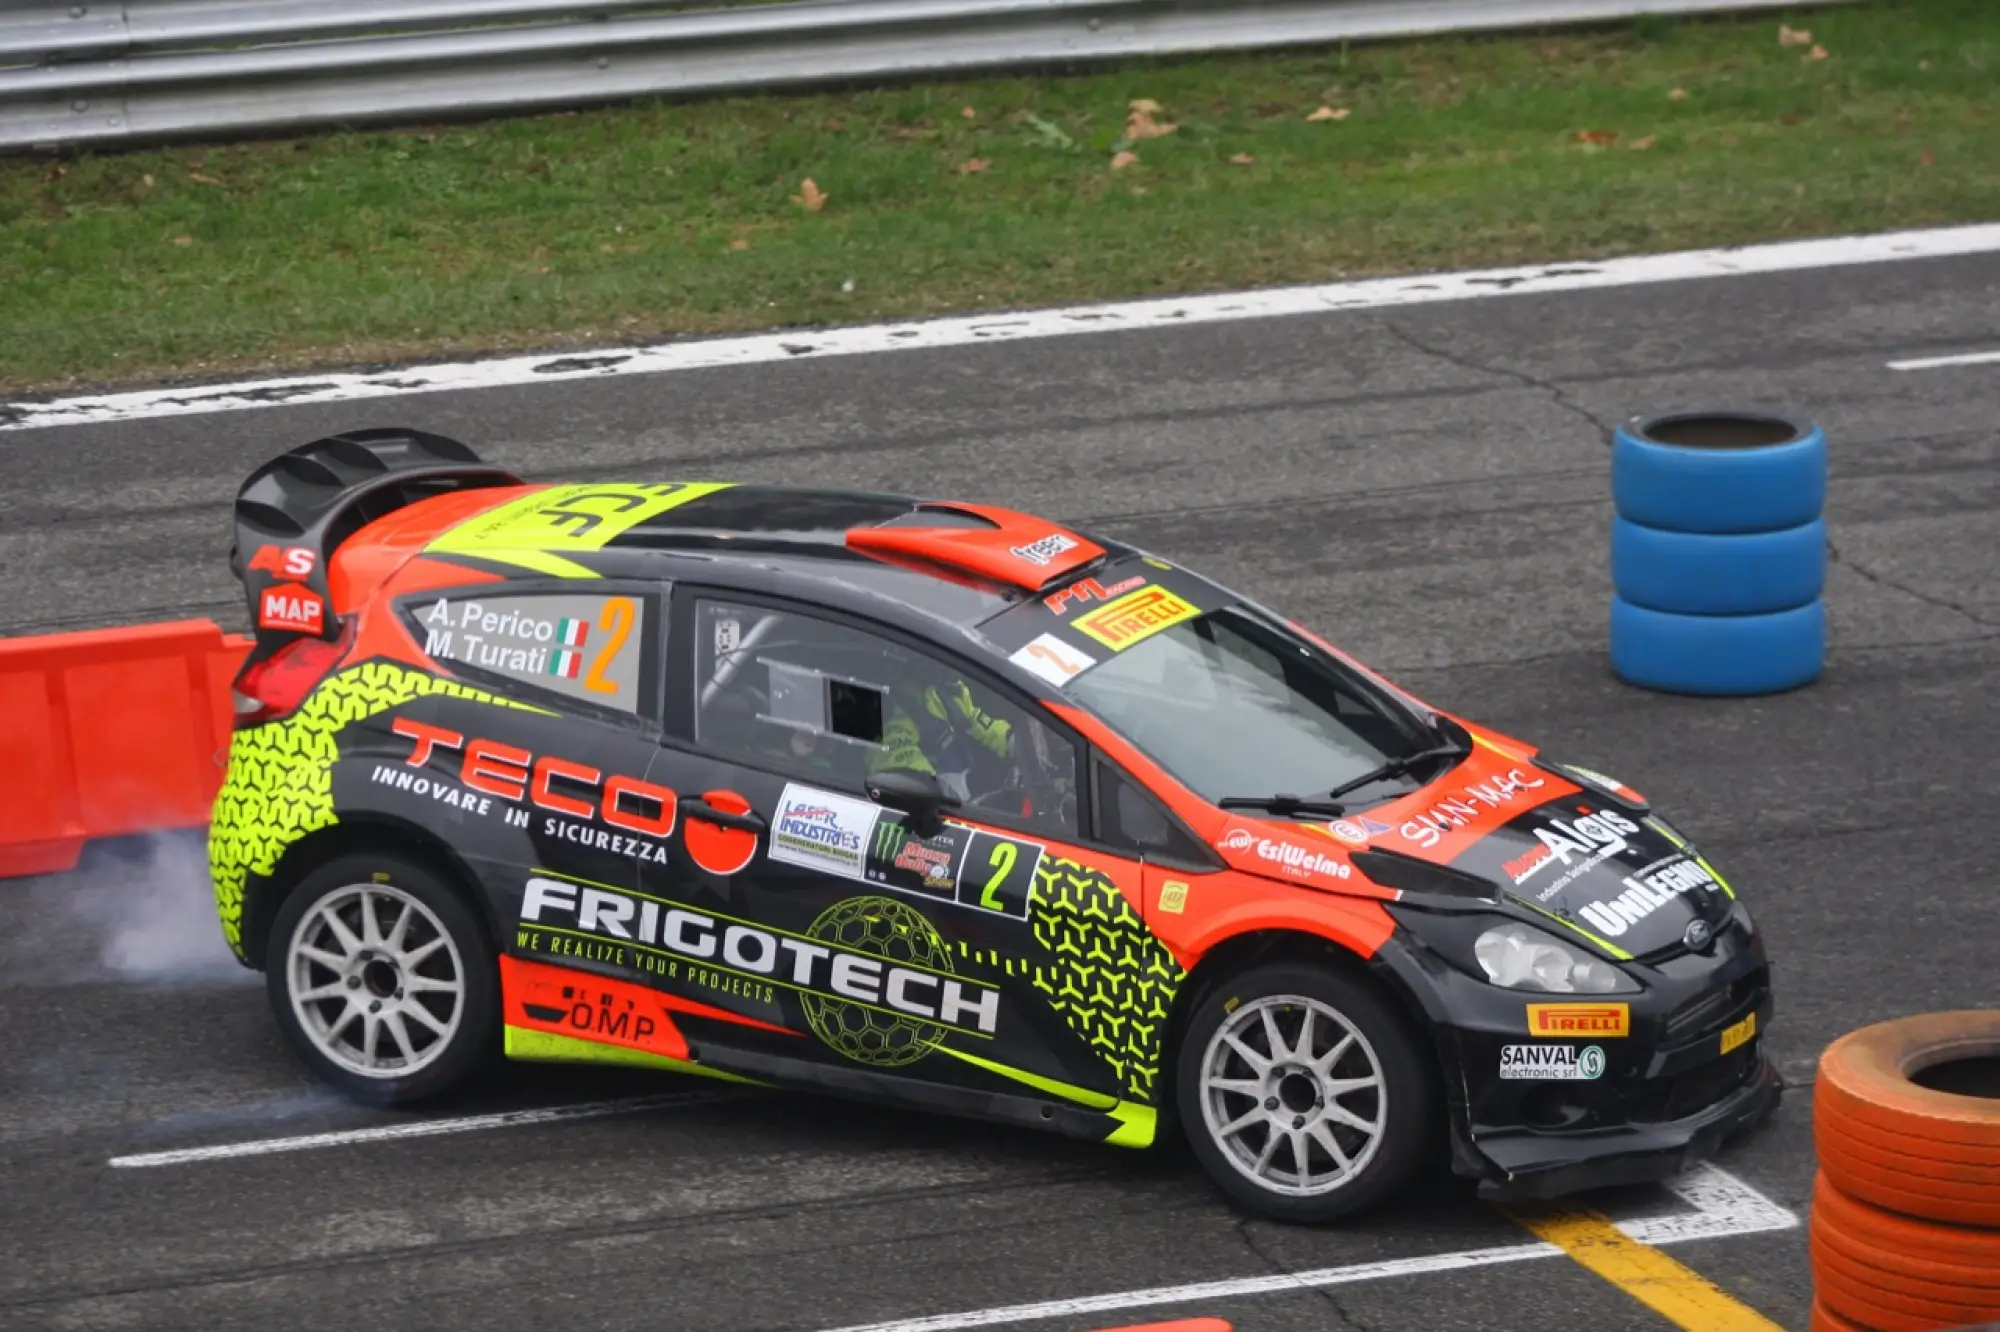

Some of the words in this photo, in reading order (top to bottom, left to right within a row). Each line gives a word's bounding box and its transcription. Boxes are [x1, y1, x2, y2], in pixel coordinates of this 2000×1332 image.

[266, 594, 321, 622] MAP
[427, 598, 456, 627] A.
[461, 602, 553, 642] Perico
[1085, 591, 1186, 643] PIRELLI
[424, 628, 456, 660] M.
[463, 634, 548, 675] Turati
[583, 595, 636, 695] 2
[1026, 642, 1082, 676] 2
[392, 716, 678, 839] TECO
[372, 765, 492, 816] INNOVARE
[504, 806, 530, 829] IN
[544, 818, 668, 865] SICUREZZA
[1533, 804, 1640, 866] Algis
[979, 842, 1018, 912] 2
[1282, 865, 1312, 879] ITALY
[516, 931, 540, 951] WE
[550, 936, 625, 966] REALIZE
[635, 953, 678, 979] YOUR
[688, 966, 774, 1005] PROJECTS
[519, 877, 999, 1033] FRIGOTECH
[1538, 1009, 1621, 1031] PIRELLI
[1501, 1046, 1578, 1066] SANVAL
[1501, 1066, 1559, 1078] electronic
[1562, 1066, 1578, 1078] srl
